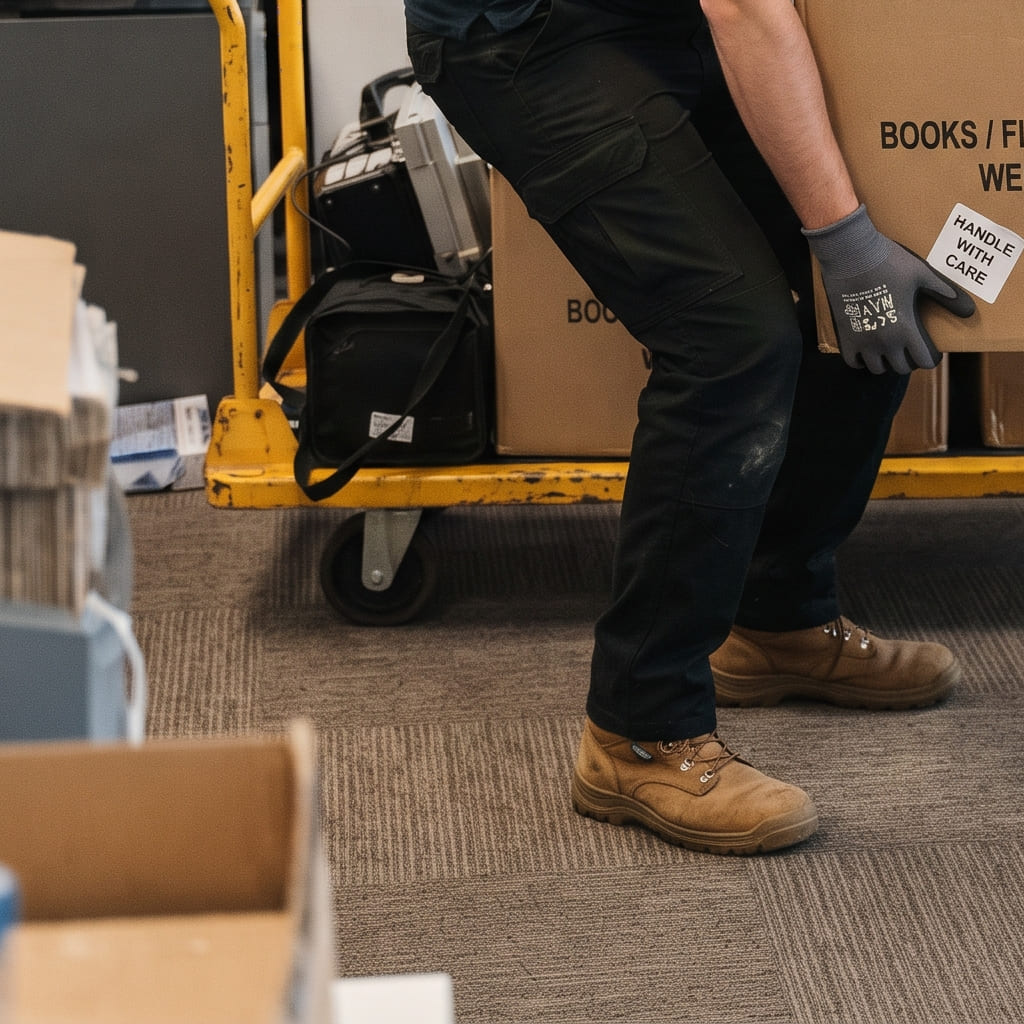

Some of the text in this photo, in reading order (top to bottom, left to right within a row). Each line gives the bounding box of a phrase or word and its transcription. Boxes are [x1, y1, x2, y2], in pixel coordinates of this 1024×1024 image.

[880, 119, 978, 150] BOOKS
[985, 119, 994, 149] /
[953, 214, 1016, 258] HANDLE
[957, 236, 995, 267] WITH
[945, 254, 988, 286] CARE
[567, 299, 618, 324] BOO
